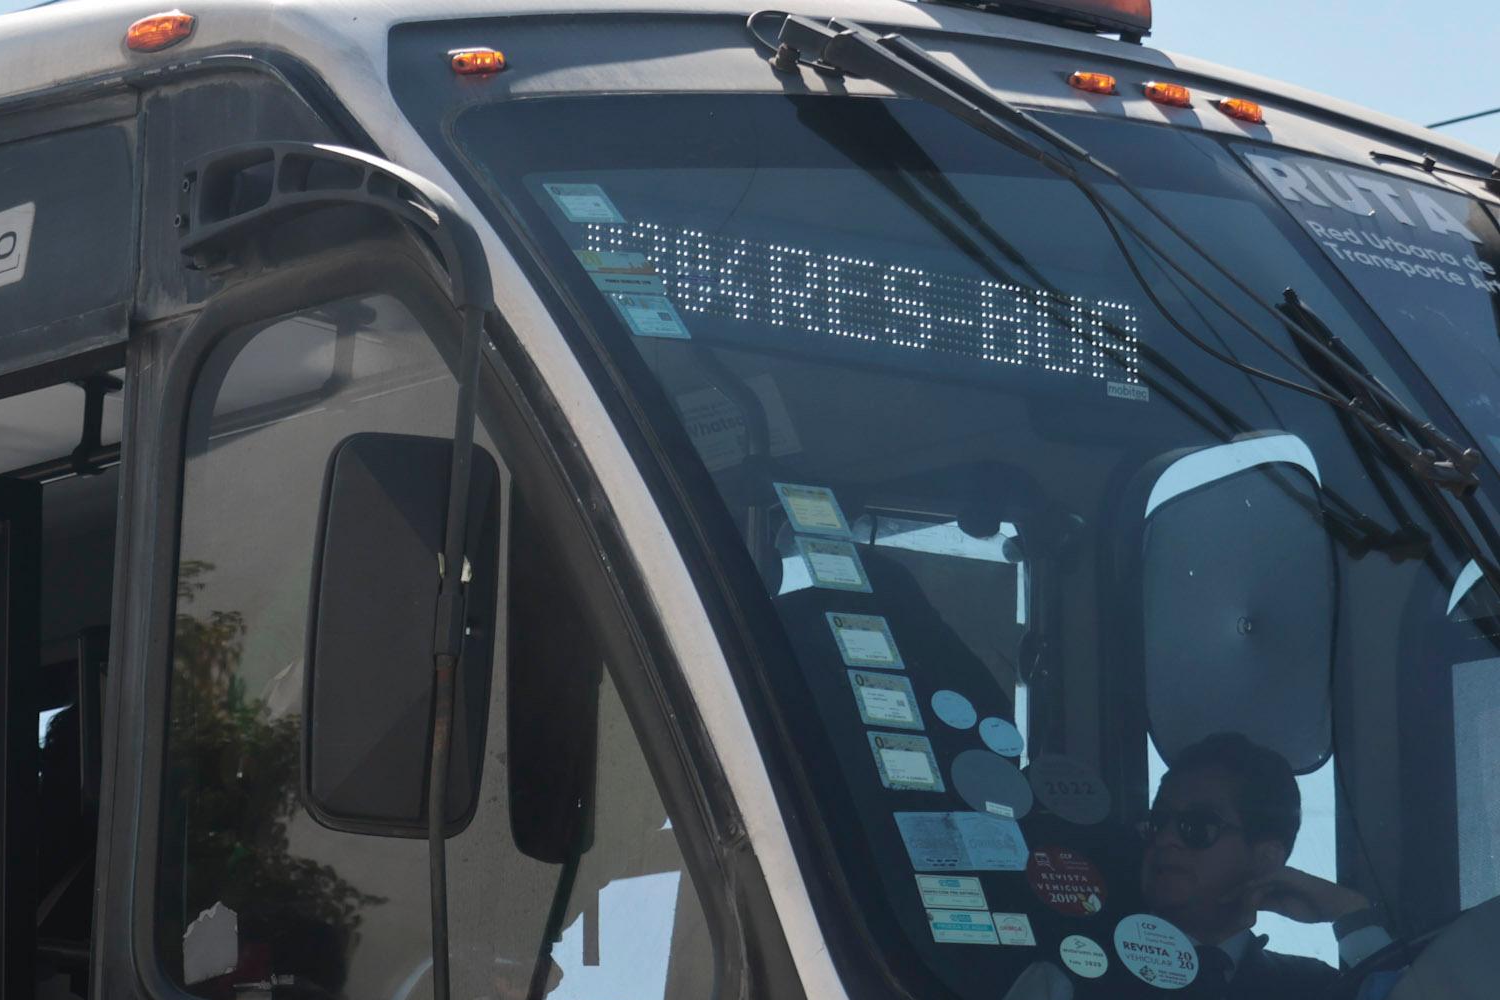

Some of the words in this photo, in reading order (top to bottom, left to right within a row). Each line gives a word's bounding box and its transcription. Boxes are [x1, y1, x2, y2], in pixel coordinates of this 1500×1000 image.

[1243, 152, 1483, 244] RUTA
[1306, 219, 1360, 244] Red
[1362, 230, 1460, 267] Urbana
[1462, 254, 1496, 275] de
[1323, 241, 1466, 286] Transporte
[1108, 383, 1148, 399] mobitec
[1045, 780, 1096, 796] 2022
[1041, 872, 1088, 882] REVISTA
[1037, 883, 1100, 893] VEHICULAR
[1050, 893, 1078, 904] 2019
[1122, 941, 1170, 957] REVISTA
[1125, 953, 1172, 967] VEHICULAR
